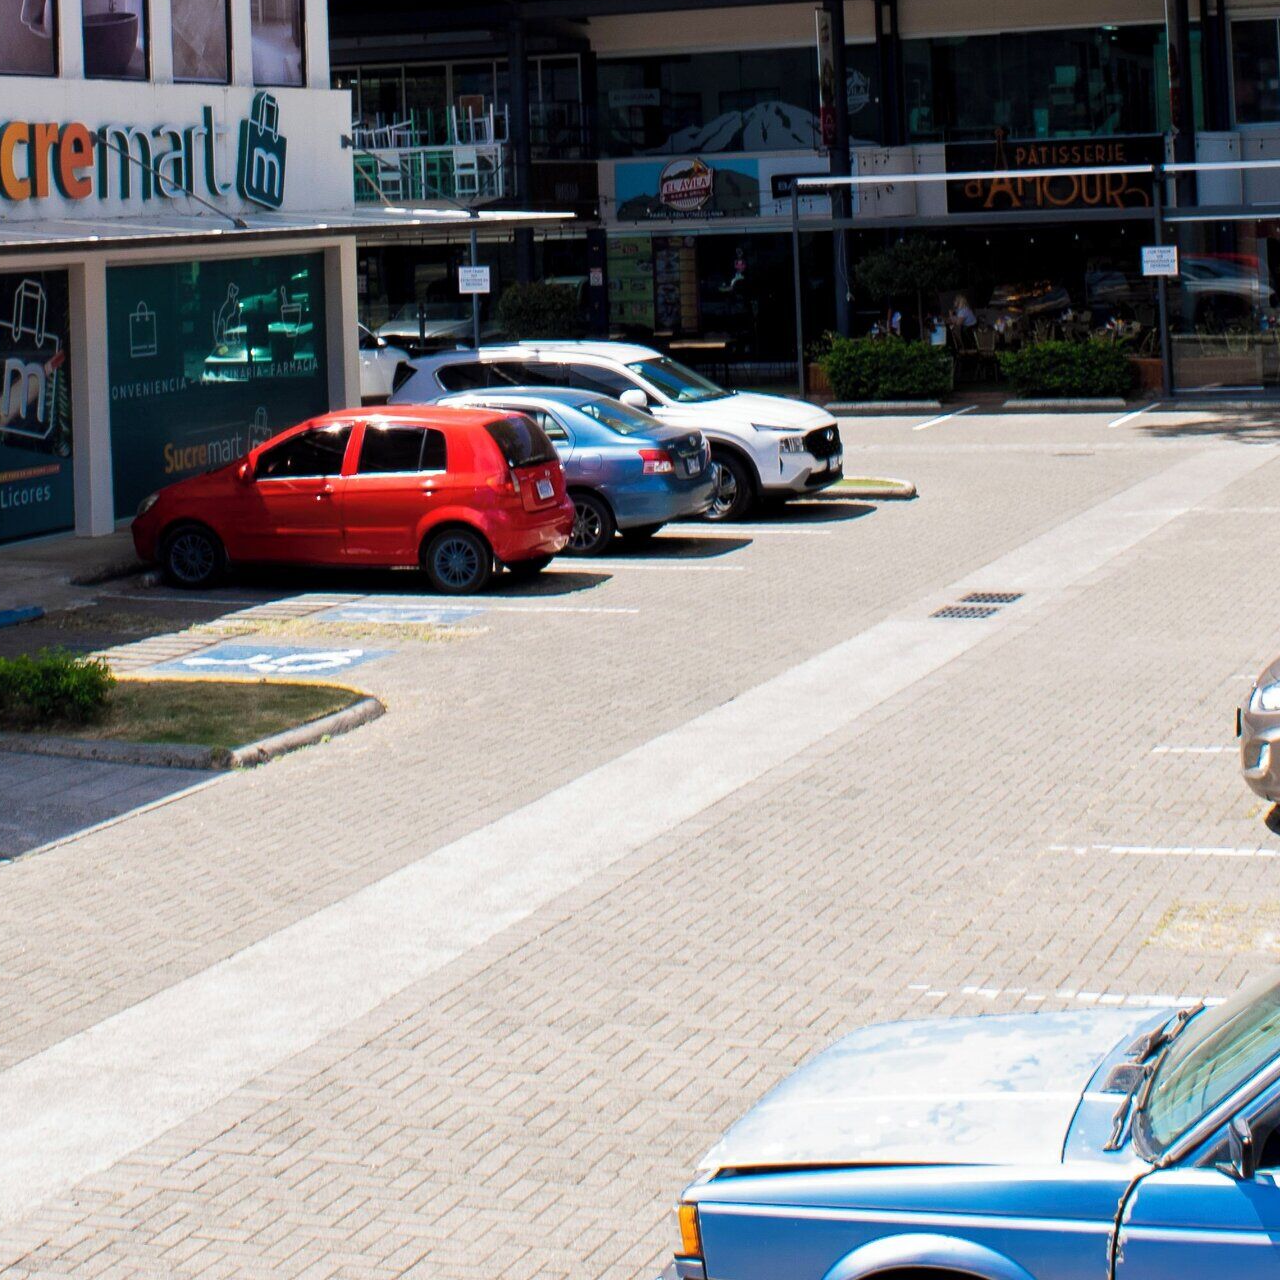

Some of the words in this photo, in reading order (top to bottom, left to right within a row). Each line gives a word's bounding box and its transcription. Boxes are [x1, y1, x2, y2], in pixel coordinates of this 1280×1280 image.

[111, 377, 187, 400] ONVENIENCIA
[271, 358, 319, 377] FARMACIA
[164, 432, 244, 474] Sucremart
[0, 484, 51, 509] Licores
